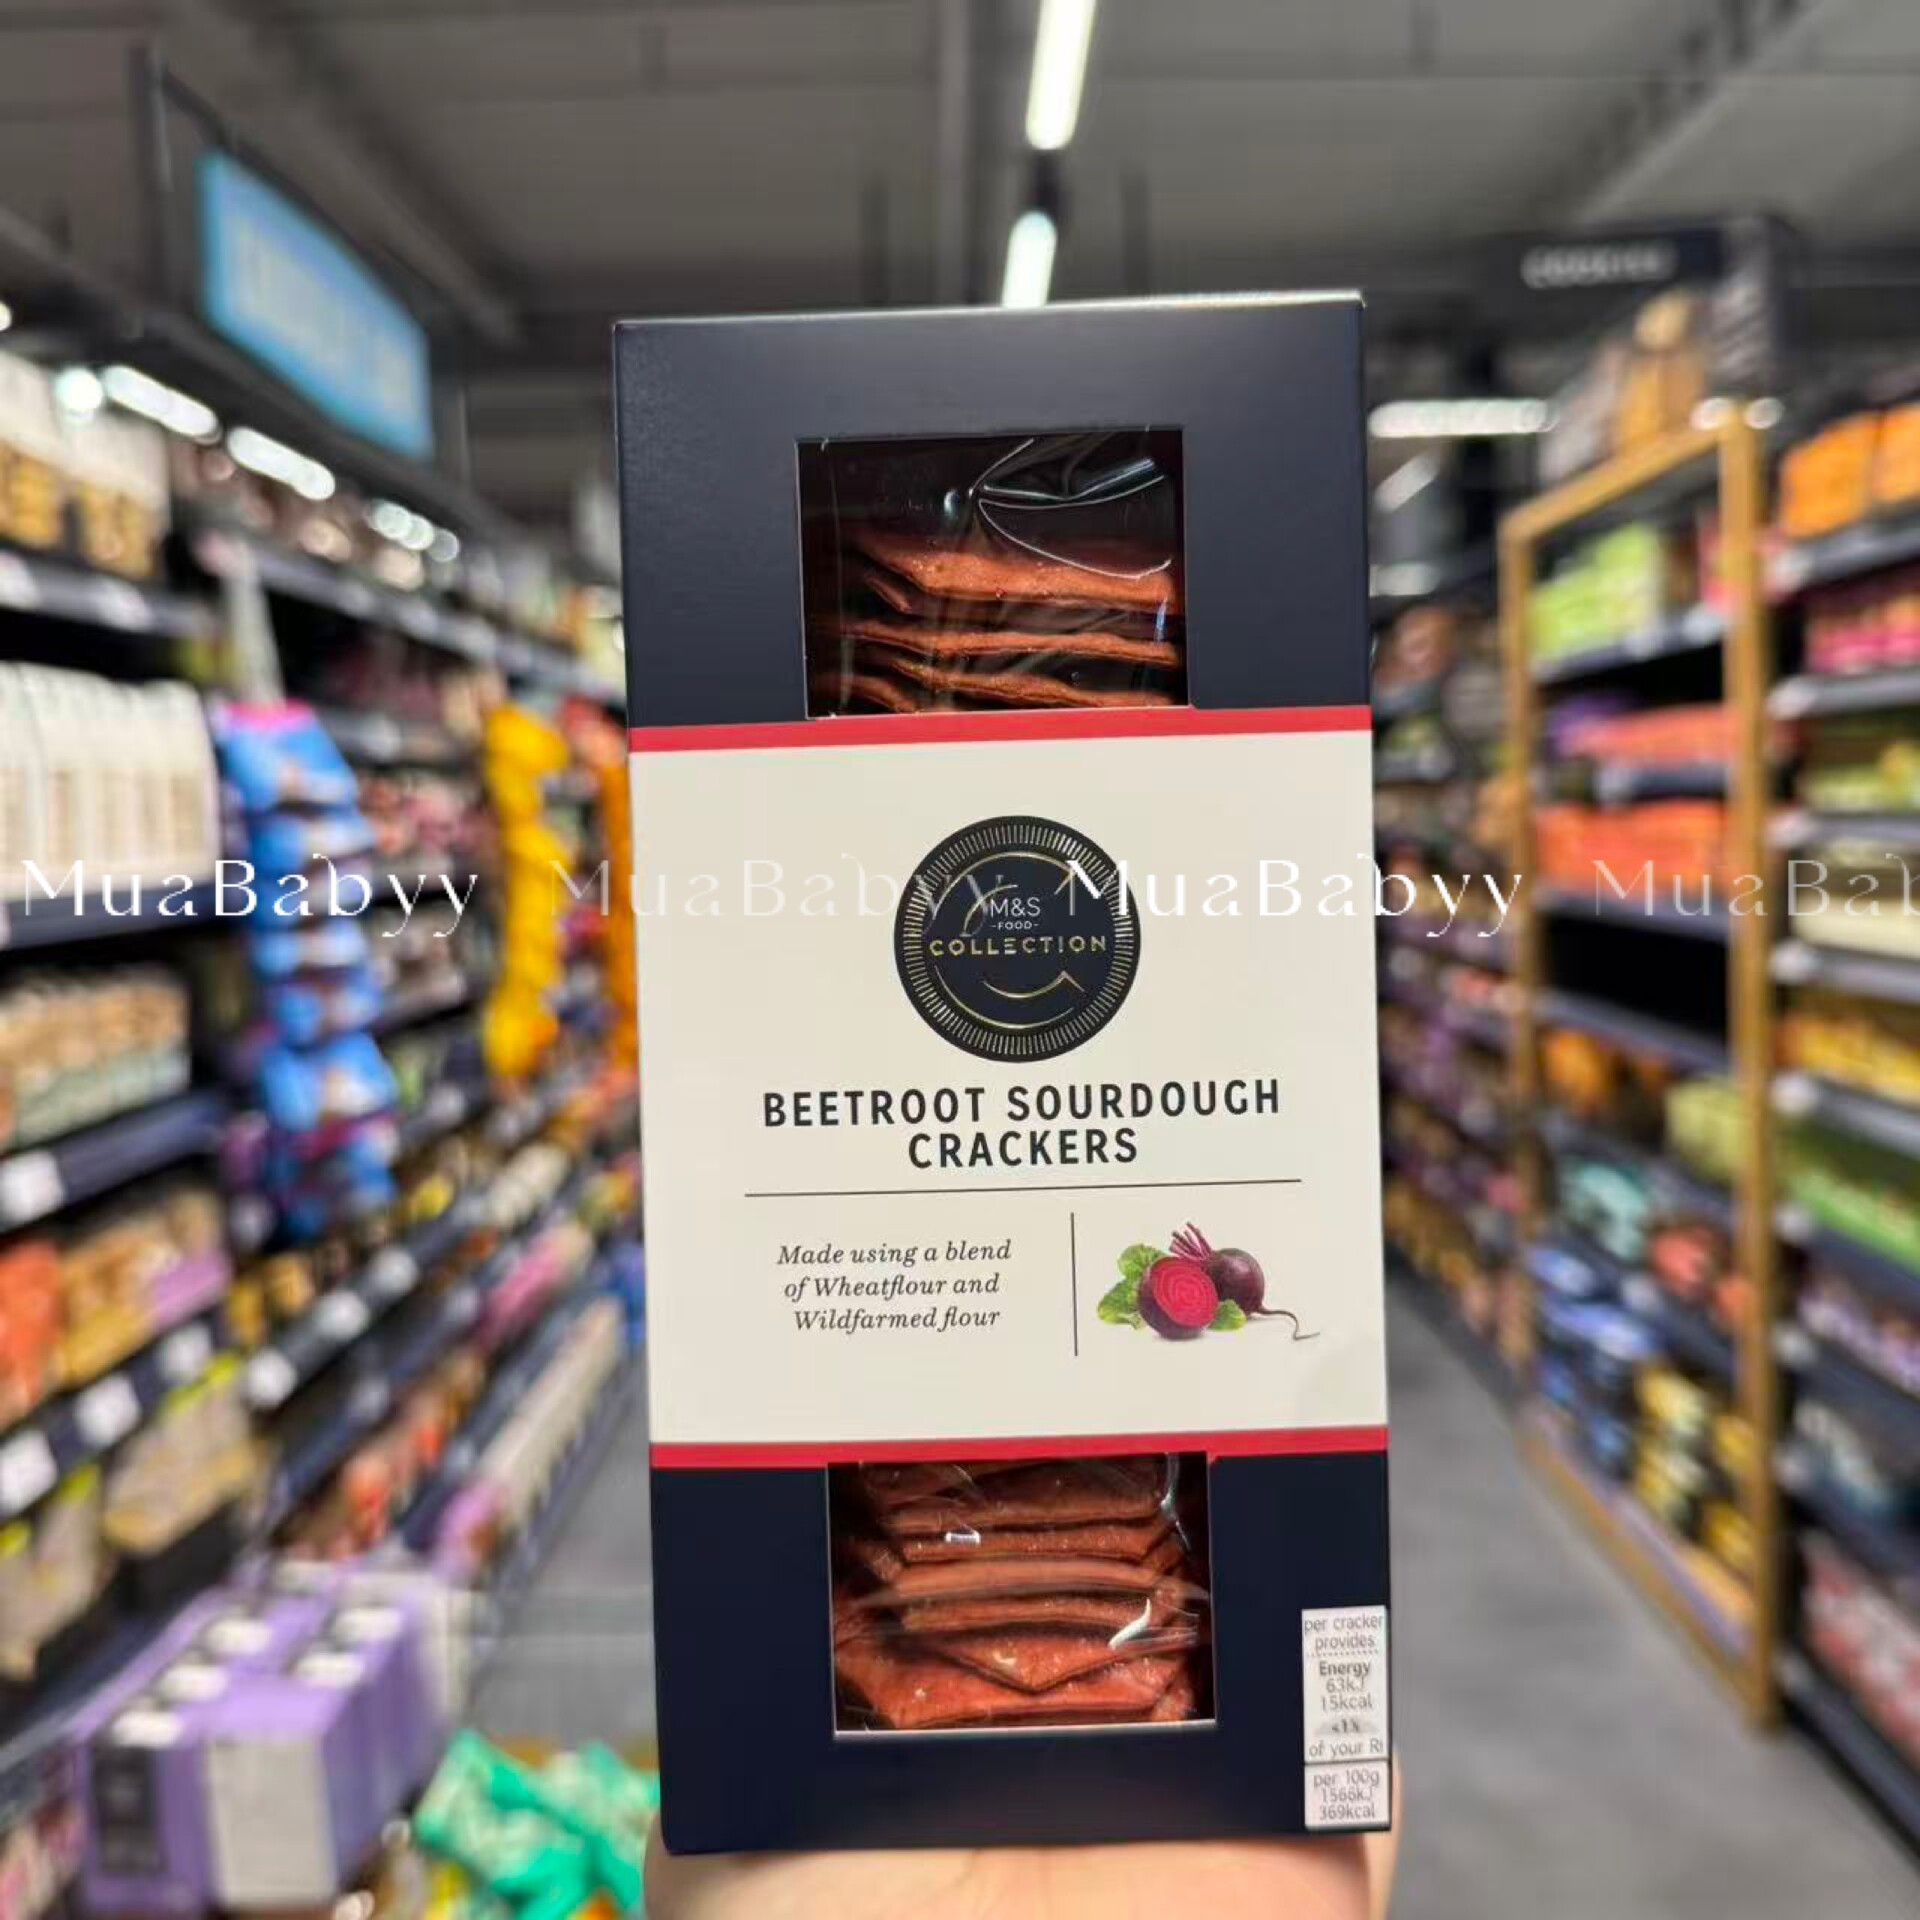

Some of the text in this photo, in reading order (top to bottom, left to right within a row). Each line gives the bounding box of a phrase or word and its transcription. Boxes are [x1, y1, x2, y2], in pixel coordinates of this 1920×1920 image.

[989, 897, 1041, 917] M&S
[929, 936, 1106, 956] COLLECTION
[763, 1079, 1281, 1128] BEETROOT SOURDOUGH
[908, 1128, 1139, 1169] CRACKERS
[777, 1239, 1012, 1268] Made using a blend
[784, 1272, 1001, 1303] of Wheatflour and
[794, 1305, 1001, 1335] Wildfarmed flour
[1304, 1612, 1384, 1636] per cracker
[1315, 1632, 1375, 1656] provides
[1319, 1660, 1370, 1677] Energy
[1326, 1676, 1365, 1693] 63kJ
[1321, 1692, 1373, 1712] 15kcal
[1309, 1740, 1325, 1757] of
[1330, 1743, 1362, 1760] your
[1313, 1768, 1380, 1789] per 100g
[1319, 1802, 1375, 1820] 369kcal
